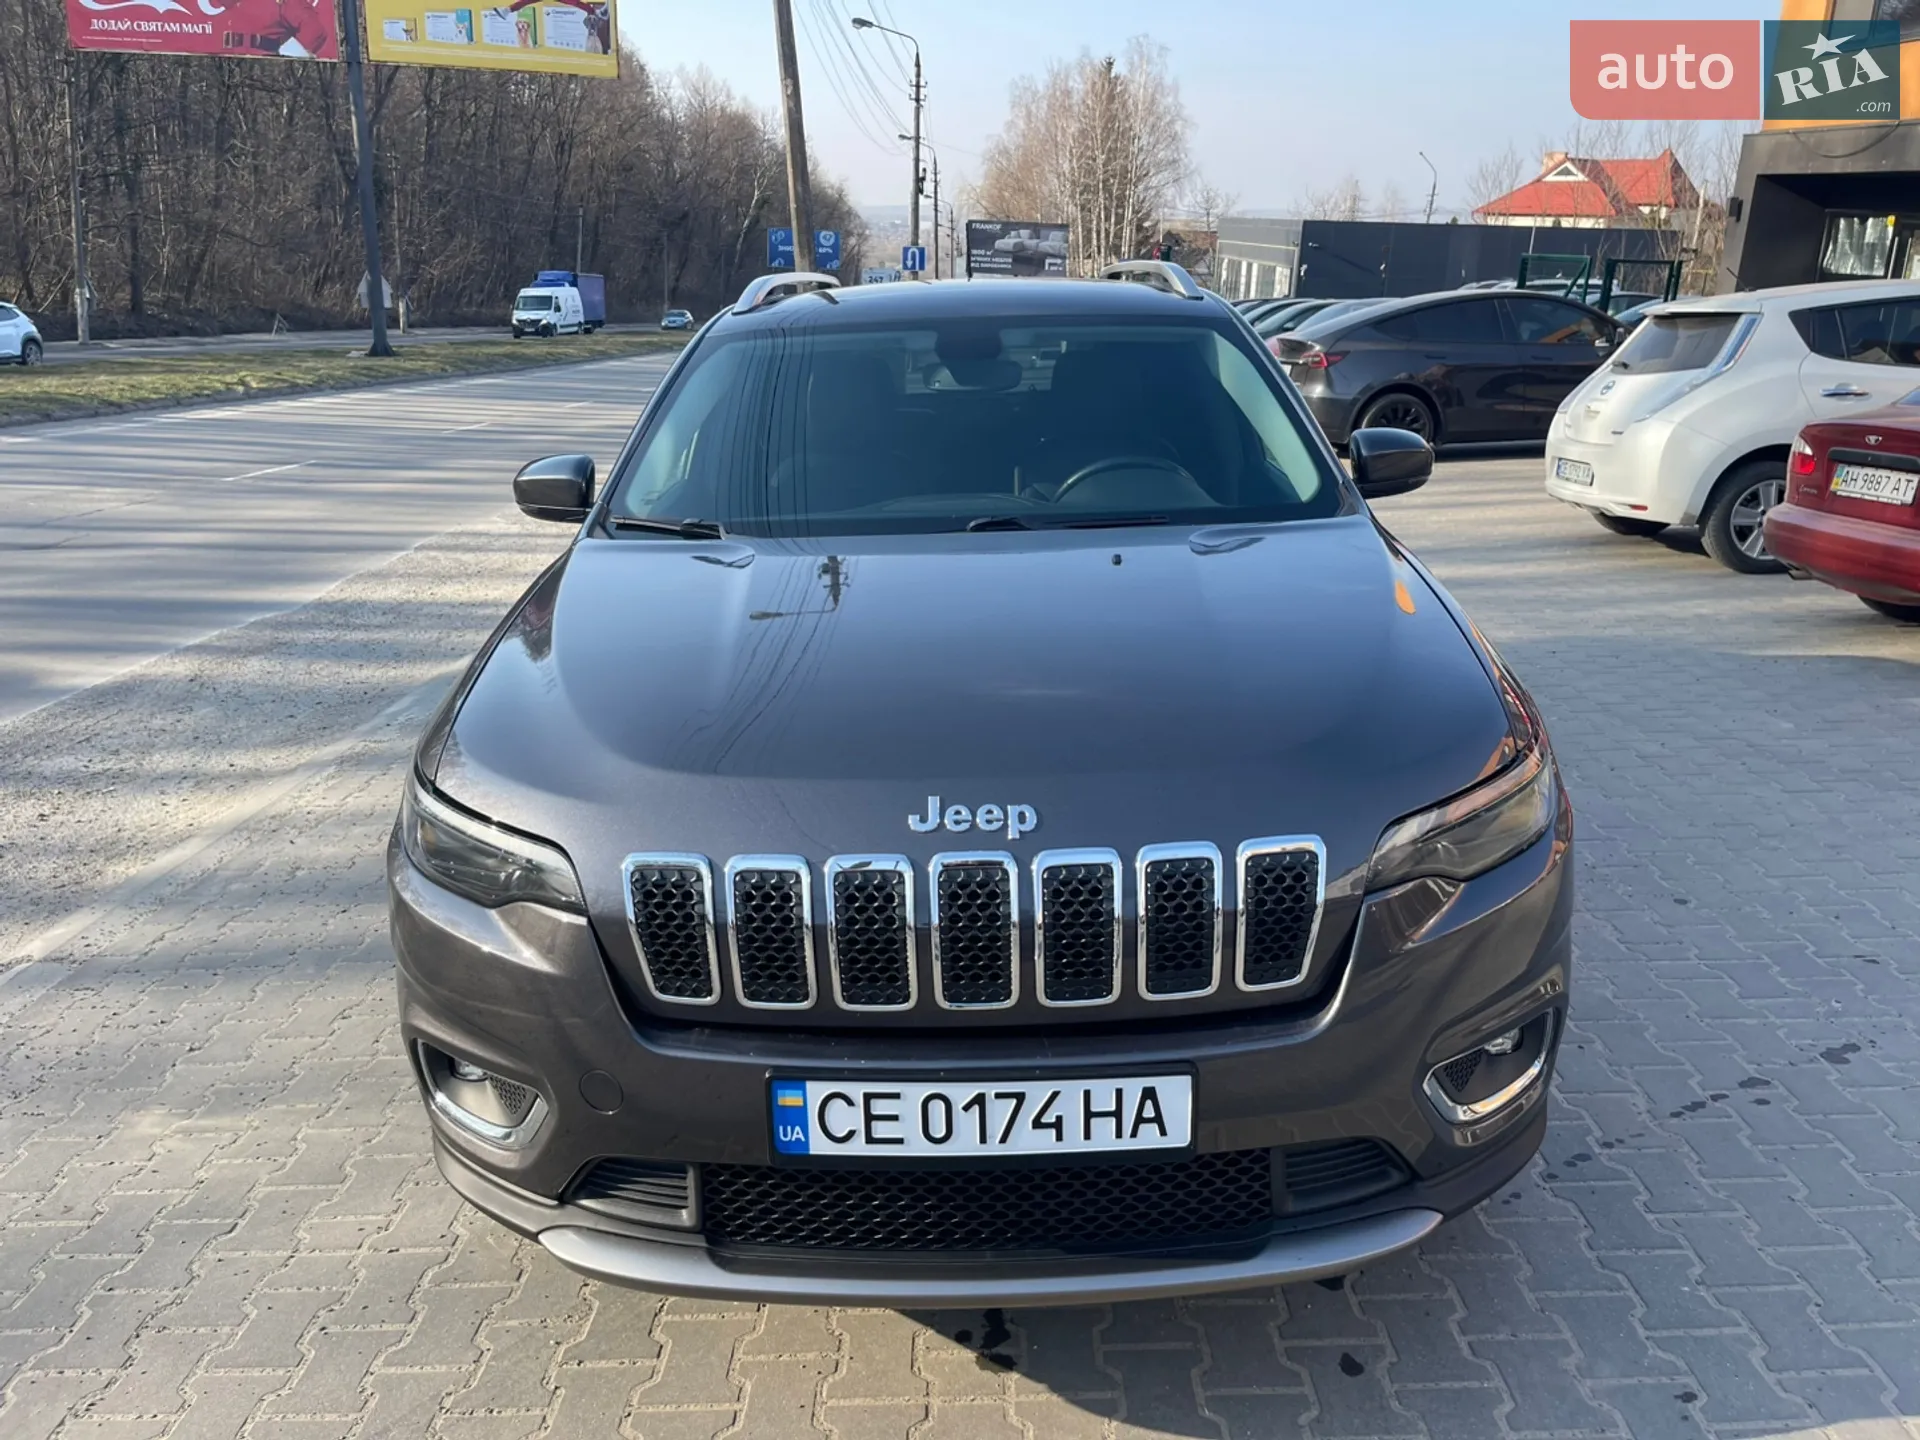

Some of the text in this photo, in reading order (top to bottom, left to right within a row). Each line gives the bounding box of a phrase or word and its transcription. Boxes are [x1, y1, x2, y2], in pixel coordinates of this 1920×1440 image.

[90, 18, 213, 34] ДОДАЙ СВЯТАМ МАГІЇ
[1840, 470, 1914, 498] AH 9887 AT
[908, 796, 1038, 840] Jeep
[817, 1085, 1169, 1146] CE 0174 HA
[779, 1125, 806, 1142] UA
